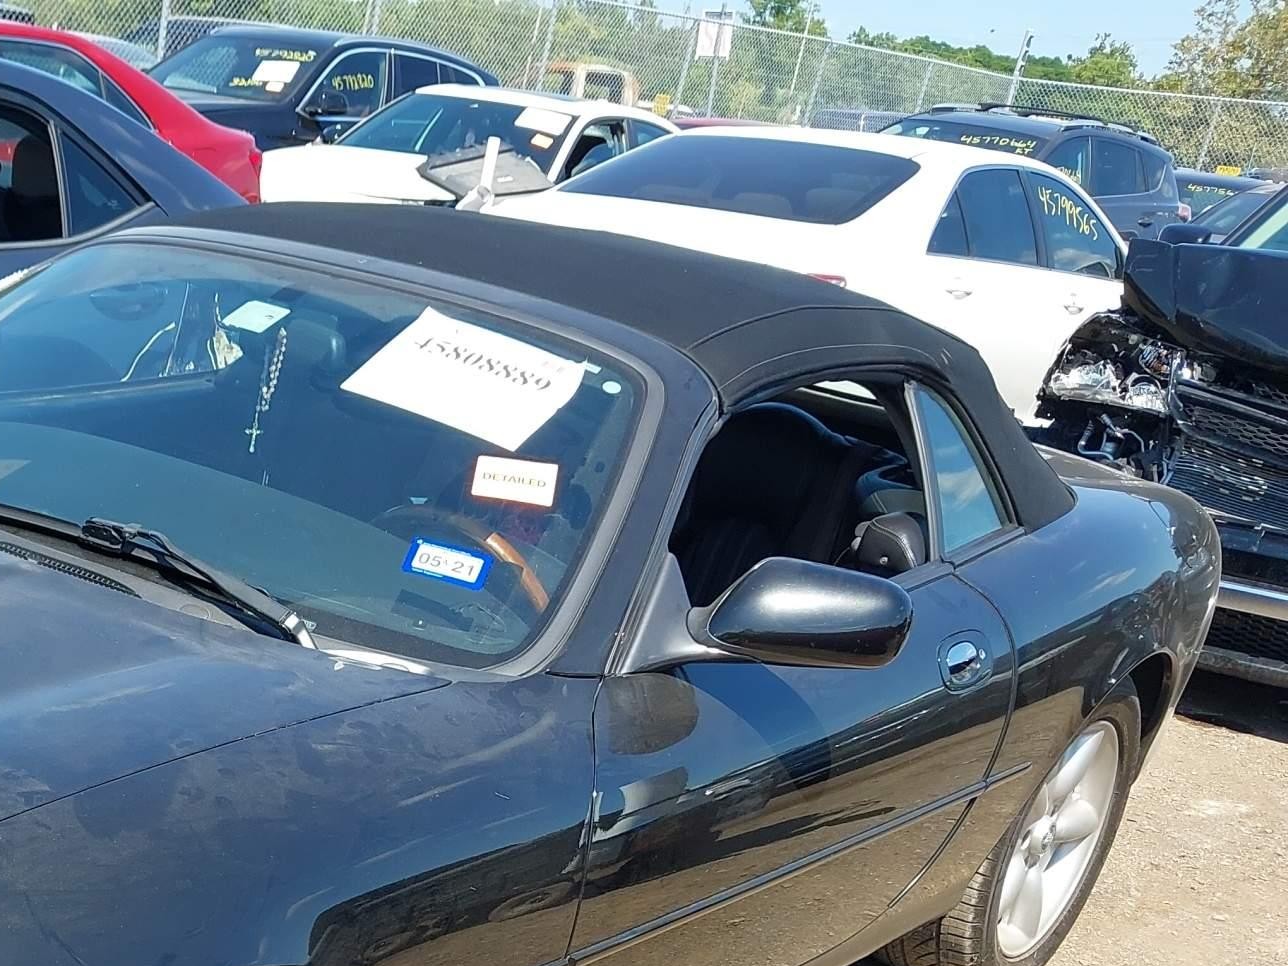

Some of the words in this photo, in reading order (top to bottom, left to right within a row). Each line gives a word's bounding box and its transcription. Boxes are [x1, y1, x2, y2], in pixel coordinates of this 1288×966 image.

[1037, 185, 1099, 241] 45799565
[414, 337, 552, 391] 45808889
[481, 471, 547, 488] DETAILED
[451, 560, 475, 577] 21
